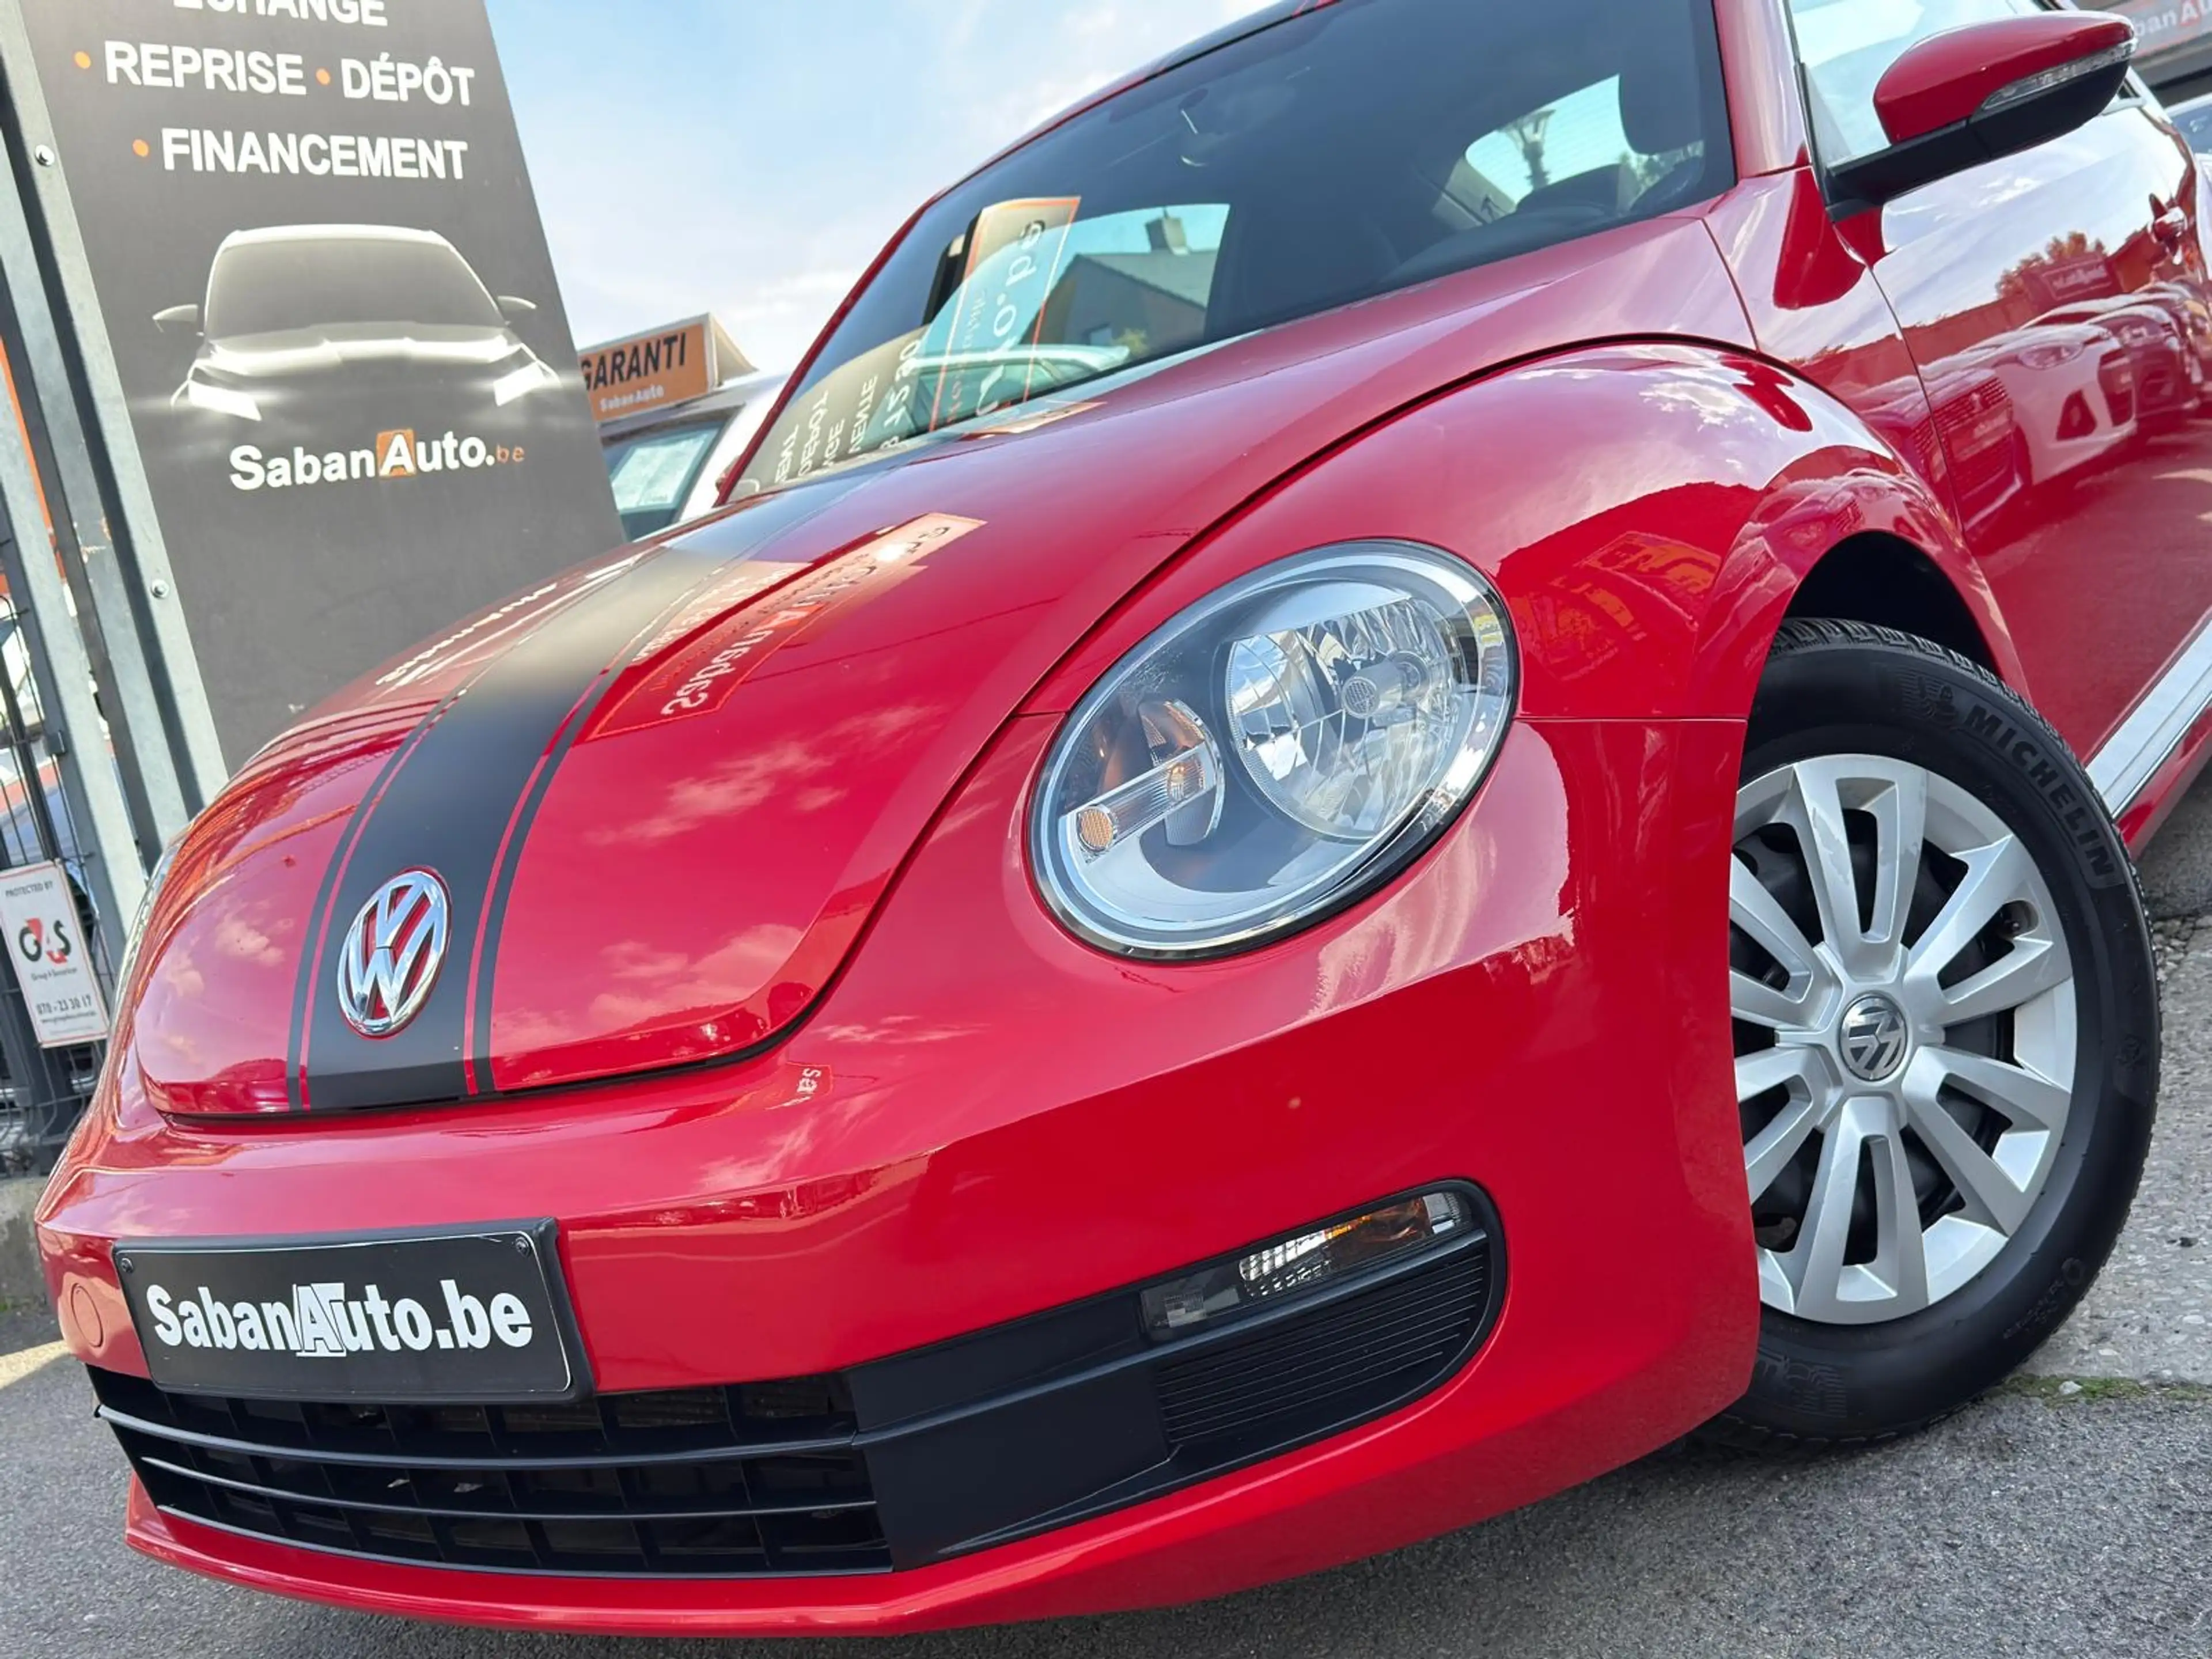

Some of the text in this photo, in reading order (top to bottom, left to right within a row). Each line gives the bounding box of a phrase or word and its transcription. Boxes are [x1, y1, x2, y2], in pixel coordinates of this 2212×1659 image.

[104, 40, 475, 106] REPRISE DÉPÔT
[162, 128, 468, 179] FINANCEMENT
[581, 332, 687, 391] GARANTI
[230, 430, 525, 490] SabanAuto.be
[1964, 703, 2116, 877] MICHELIN
[146, 1279, 533, 1358] SabanAuto.be
